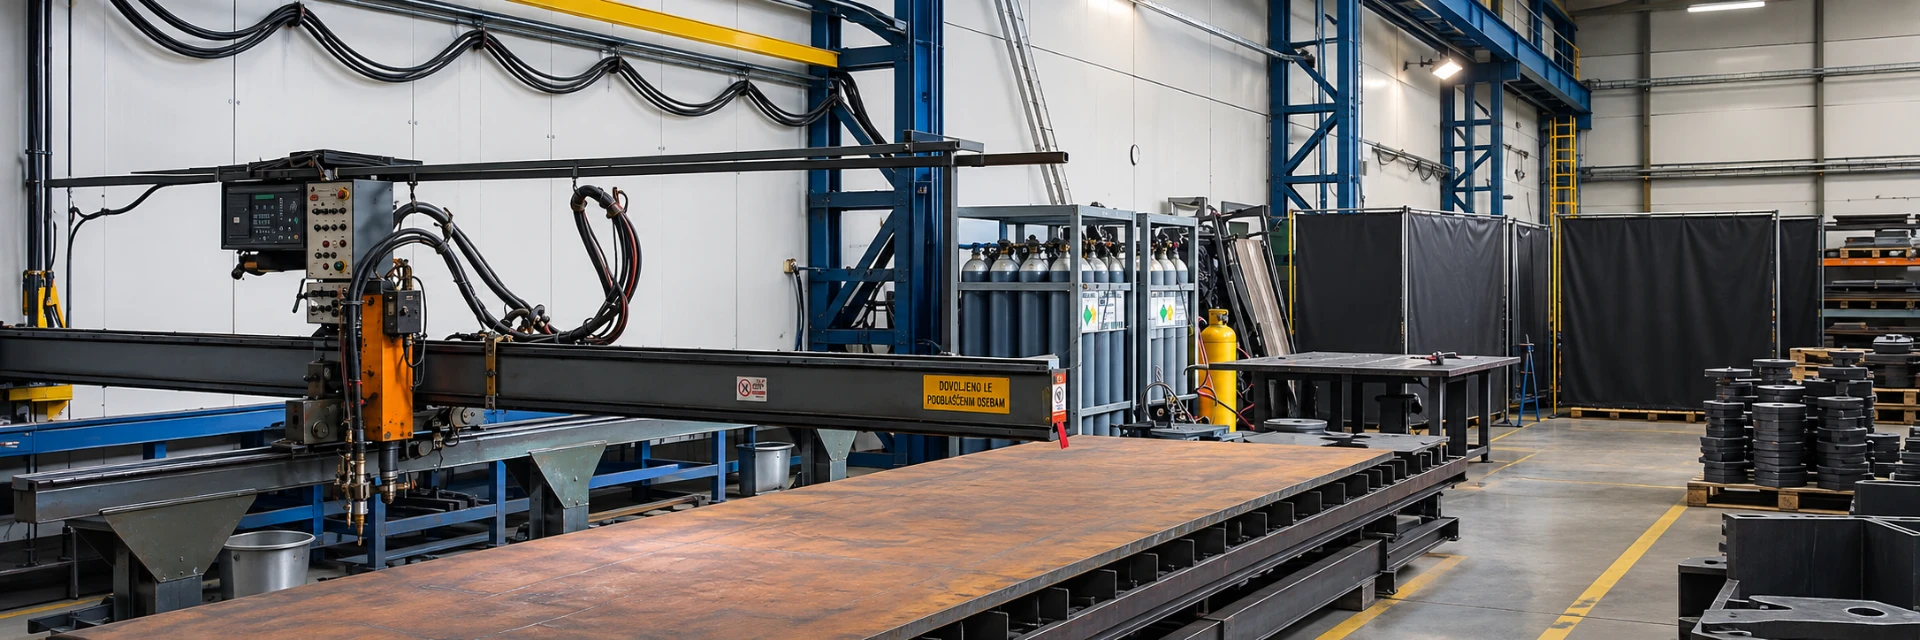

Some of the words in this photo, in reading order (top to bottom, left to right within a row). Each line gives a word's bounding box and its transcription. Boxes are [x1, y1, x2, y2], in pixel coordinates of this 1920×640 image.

[939, 380, 981, 392] DOVOLJENO
[984, 382, 992, 393] LE
[977, 397, 1005, 408] OSEBAM
